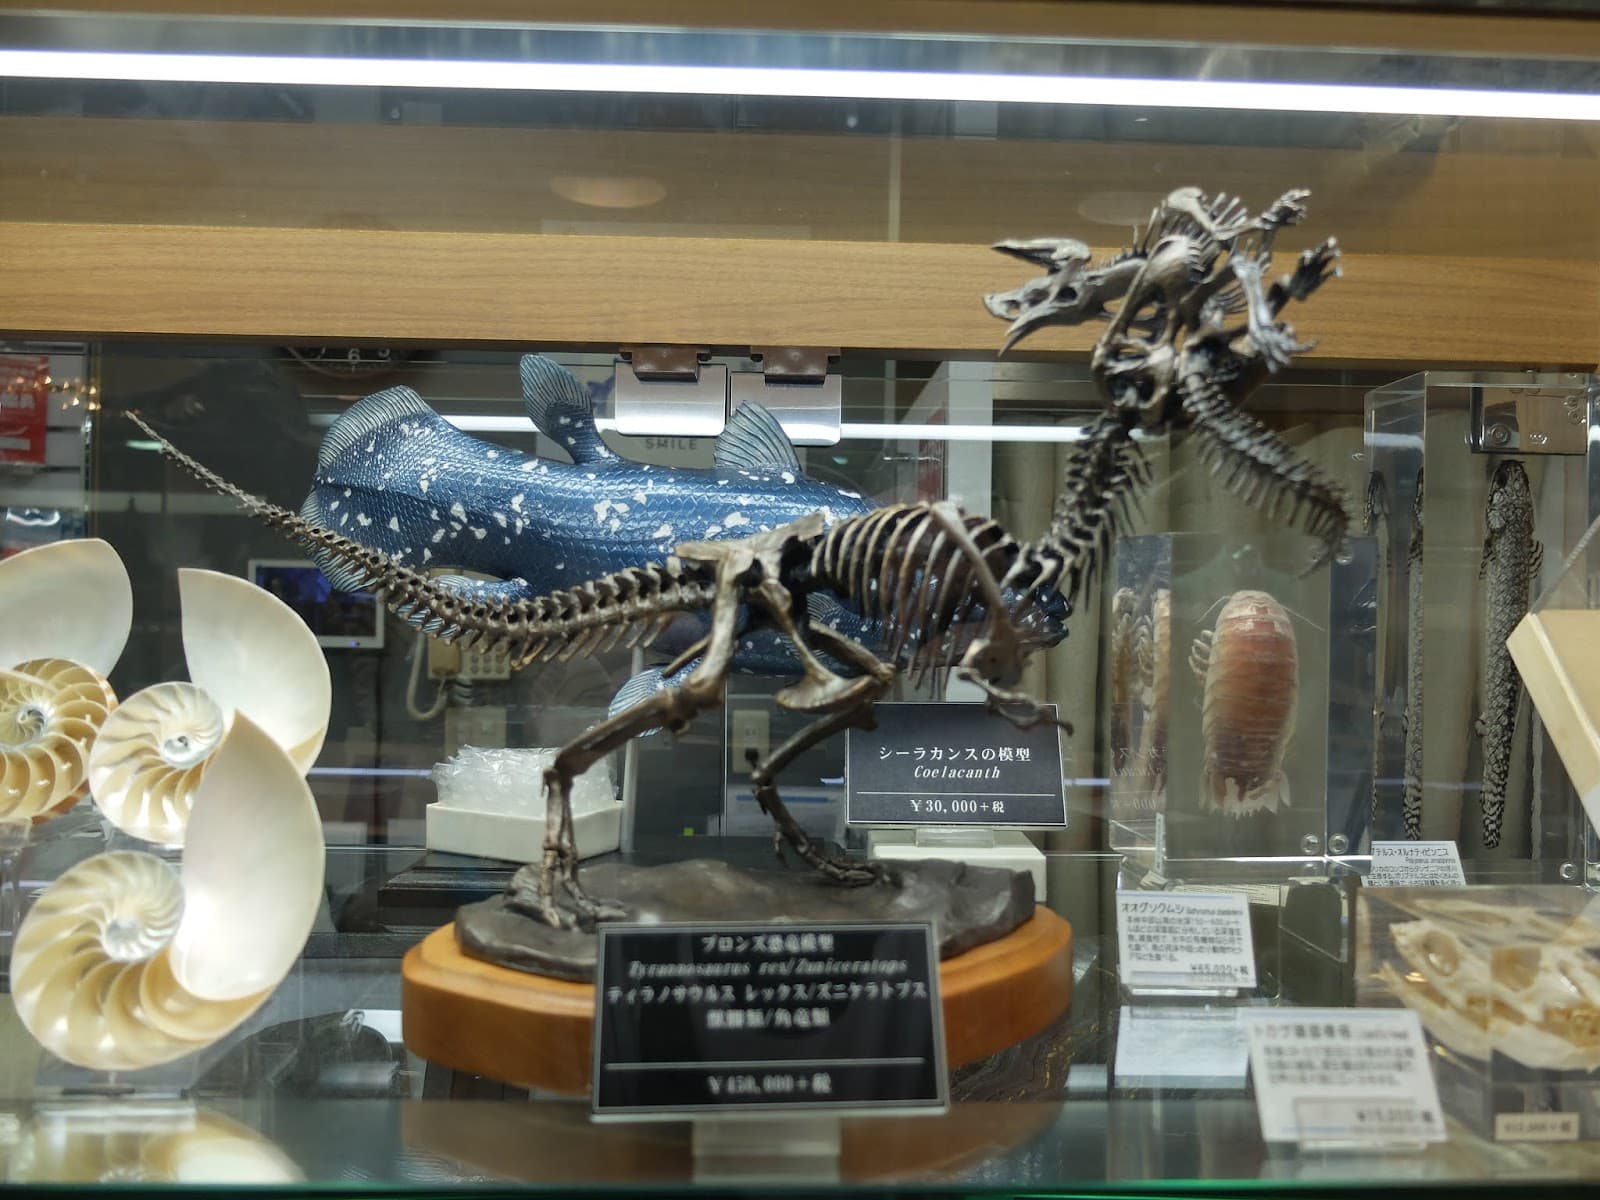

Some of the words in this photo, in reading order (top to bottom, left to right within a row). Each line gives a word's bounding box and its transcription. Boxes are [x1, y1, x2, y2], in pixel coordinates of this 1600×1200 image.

[879, 746, 1032, 762] シーラカンスの模型
[914, 765, 1001, 779] Coelacanth
